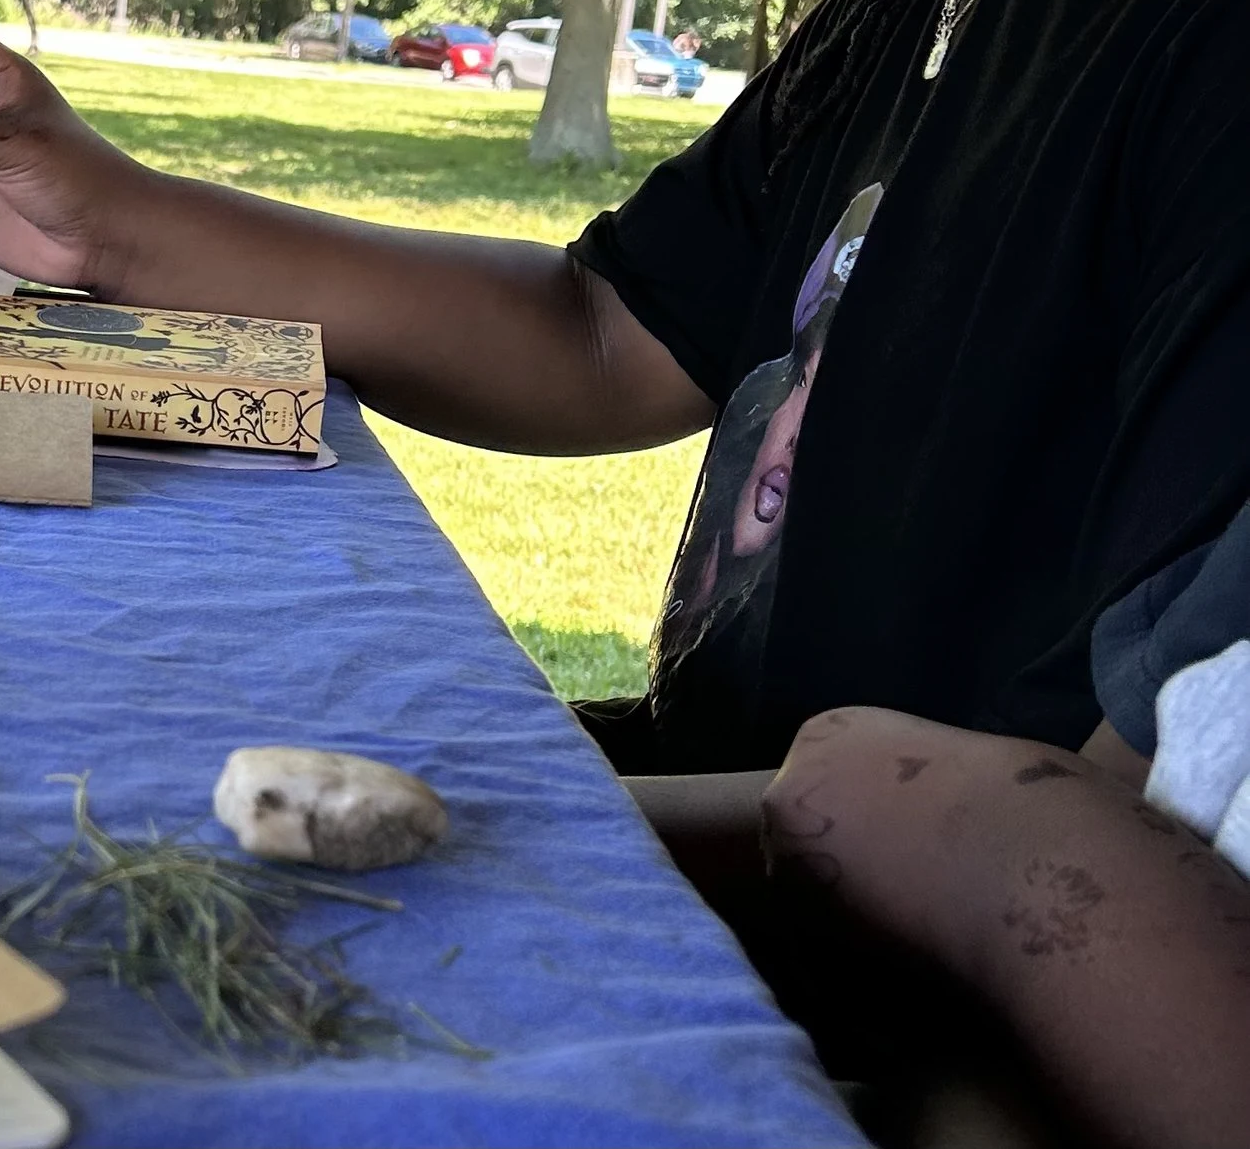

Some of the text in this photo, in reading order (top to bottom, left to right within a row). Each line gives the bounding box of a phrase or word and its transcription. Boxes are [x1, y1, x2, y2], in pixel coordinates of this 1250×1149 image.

[0, 373, 126, 402] EVOLUTION
[130, 389, 148, 401] OF
[103, 406, 168, 434] TATE
